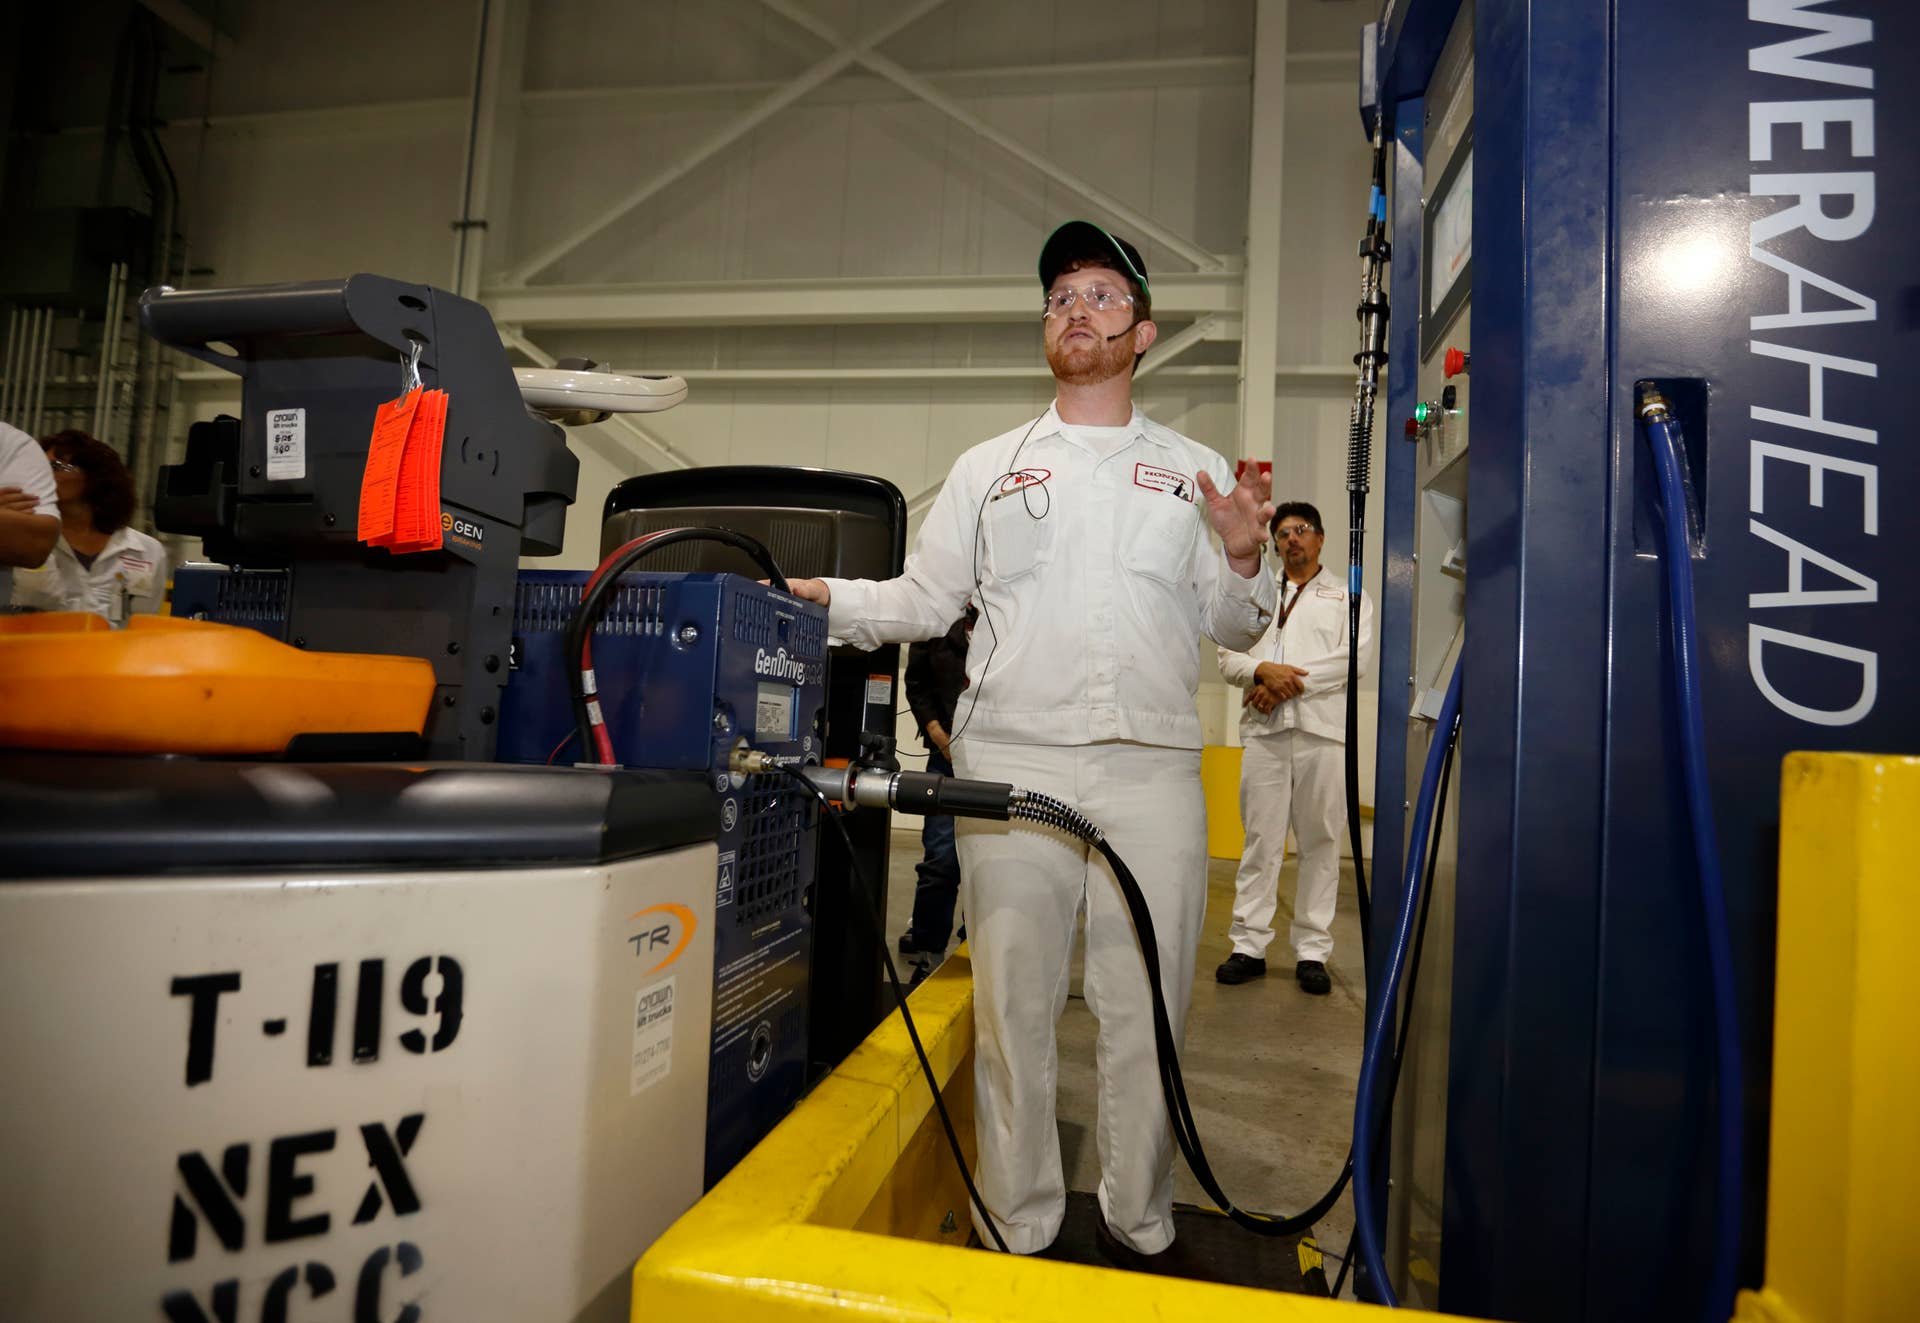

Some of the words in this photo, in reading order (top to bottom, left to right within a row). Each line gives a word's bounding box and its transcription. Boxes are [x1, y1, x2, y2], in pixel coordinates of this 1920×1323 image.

[454, 520, 483, 540] GEN
[754, 647, 805, 686] GenDrive
[627, 924, 671, 957] TR
[170, 955, 464, 1088] T-119
[637, 1012, 648, 1029] lift
[649, 1003, 673, 1023] trucks
[168, 1112, 425, 1264] NEX
